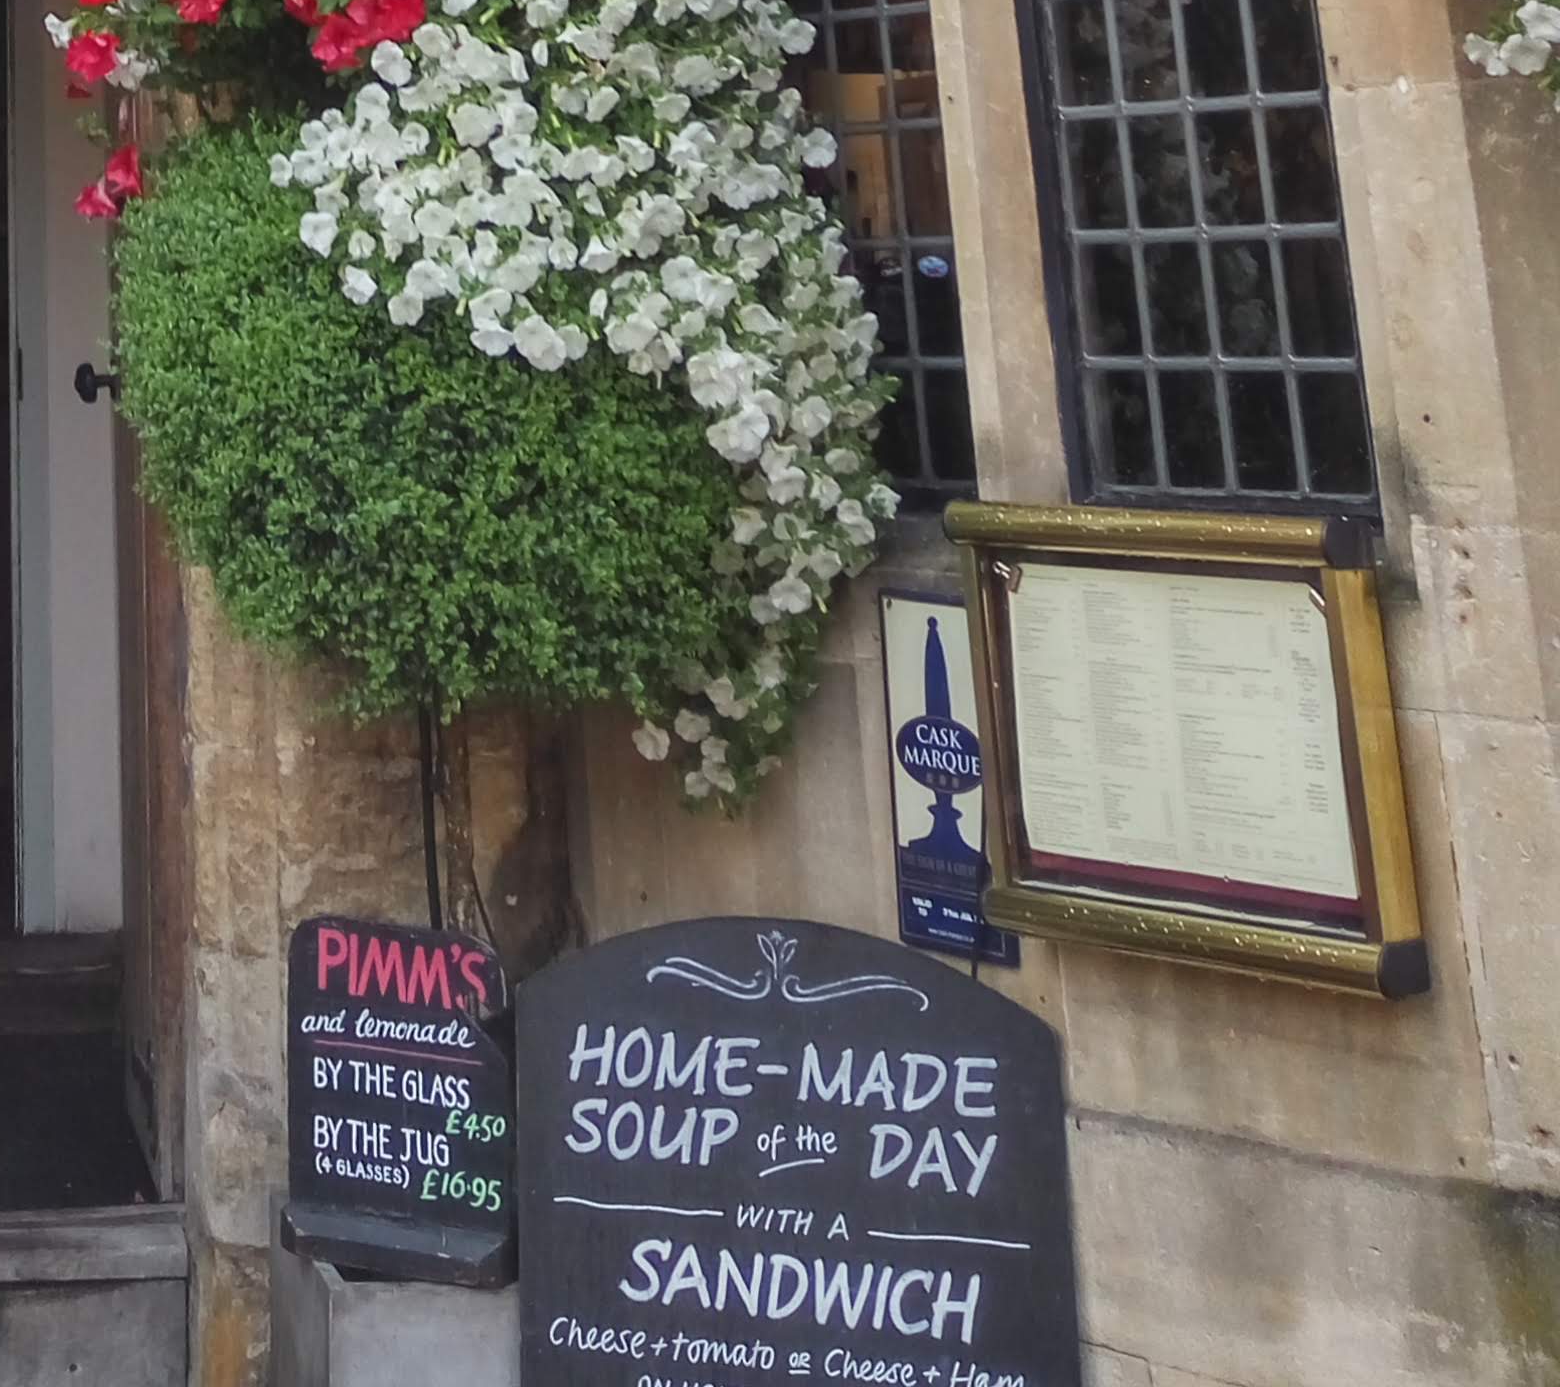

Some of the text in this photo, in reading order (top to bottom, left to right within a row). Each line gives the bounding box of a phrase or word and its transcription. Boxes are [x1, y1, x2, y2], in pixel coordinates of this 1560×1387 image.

[903, 744, 981, 777] MARQUE
[915, 724, 963, 751] CASK
[317, 927, 488, 1010] PIMM'S
[300, 1008, 476, 1049] and lemonade
[313, 1056, 472, 1111] BY THE GLASS
[568, 1023, 999, 1118] HOME-MADE
[313, 1114, 450, 1168] BY THE JUG
[444, 1109, 507, 1143] £4.50
[564, 1098, 999, 1198] SOUP of the DAY
[314, 1152, 410, 1189] (4 GLASSES)
[736, 1204, 850, 1241] WITH A
[618, 1238, 982, 1345] SANDWICH
[549, 1316, 645, 1360] Cheese
[671, 1332, 775, 1370] tomato
[789, 1352, 811, 1369] OR
[824, 1348, 917, 1387] Cheese
